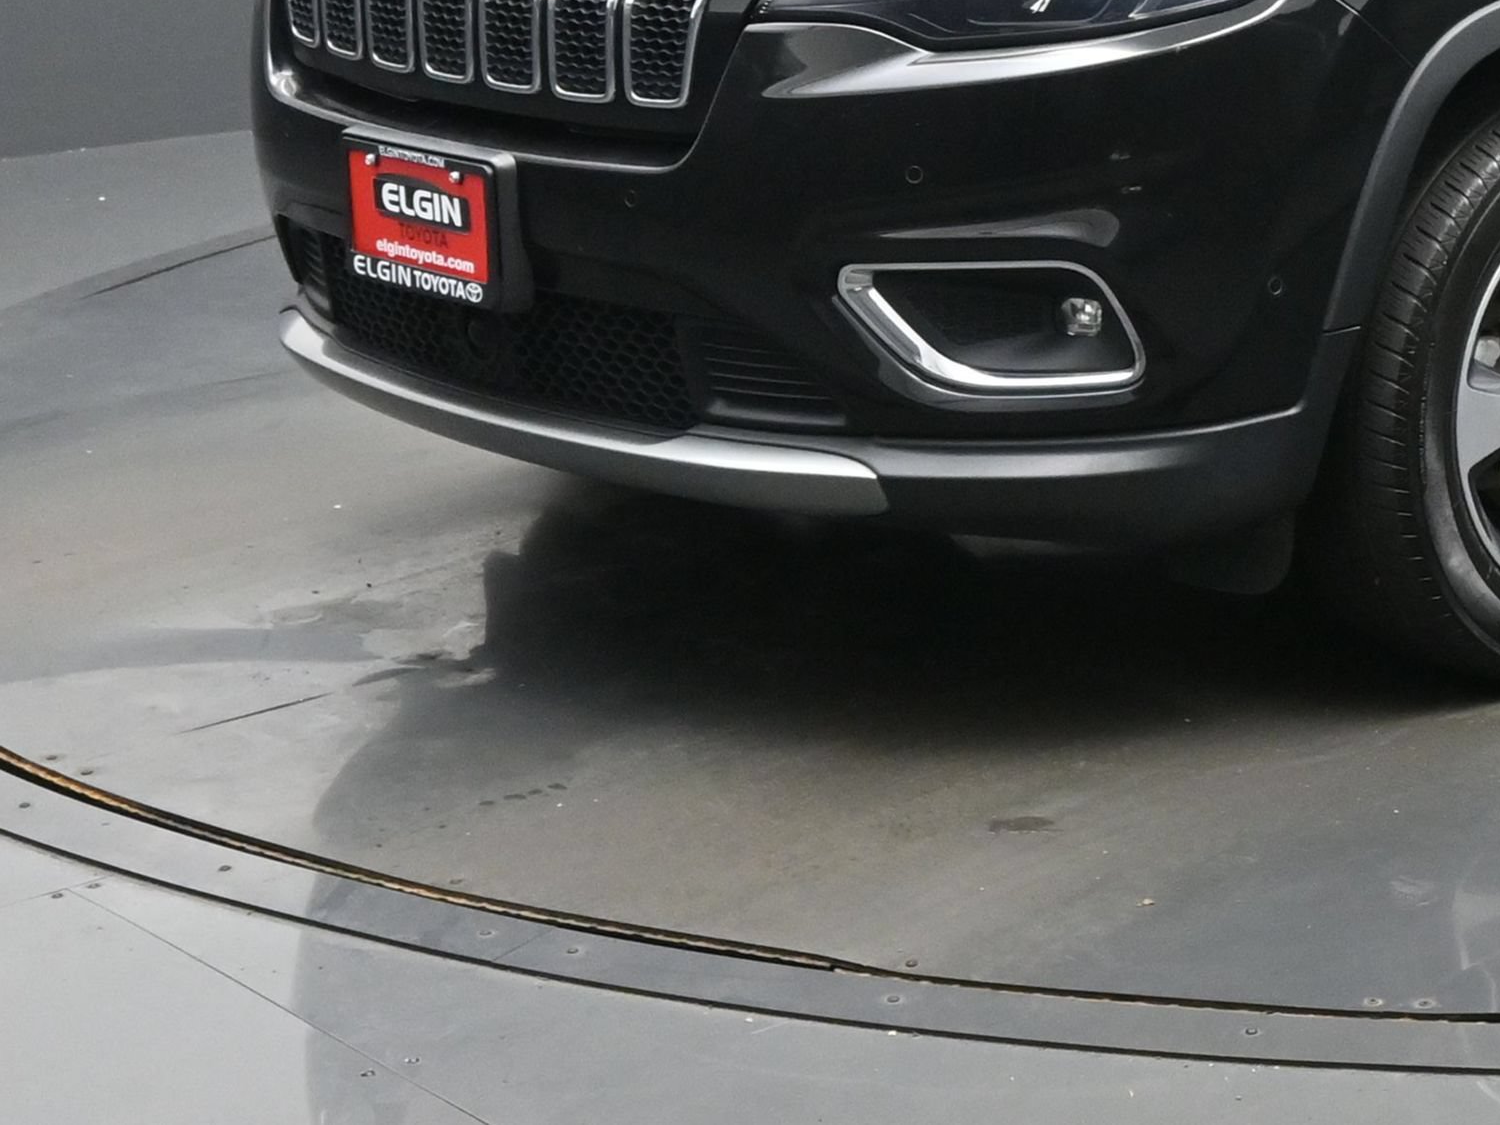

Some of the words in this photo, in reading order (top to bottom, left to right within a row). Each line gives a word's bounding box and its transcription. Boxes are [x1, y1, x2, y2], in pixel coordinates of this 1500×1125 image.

[381, 182, 462, 227] ELGIN
[400, 223, 448, 248] TOYOTA
[376, 238, 475, 274] elgintoyota.com
[353, 254, 411, 288] ELGIN
[412, 270, 466, 300] TOYOTA
